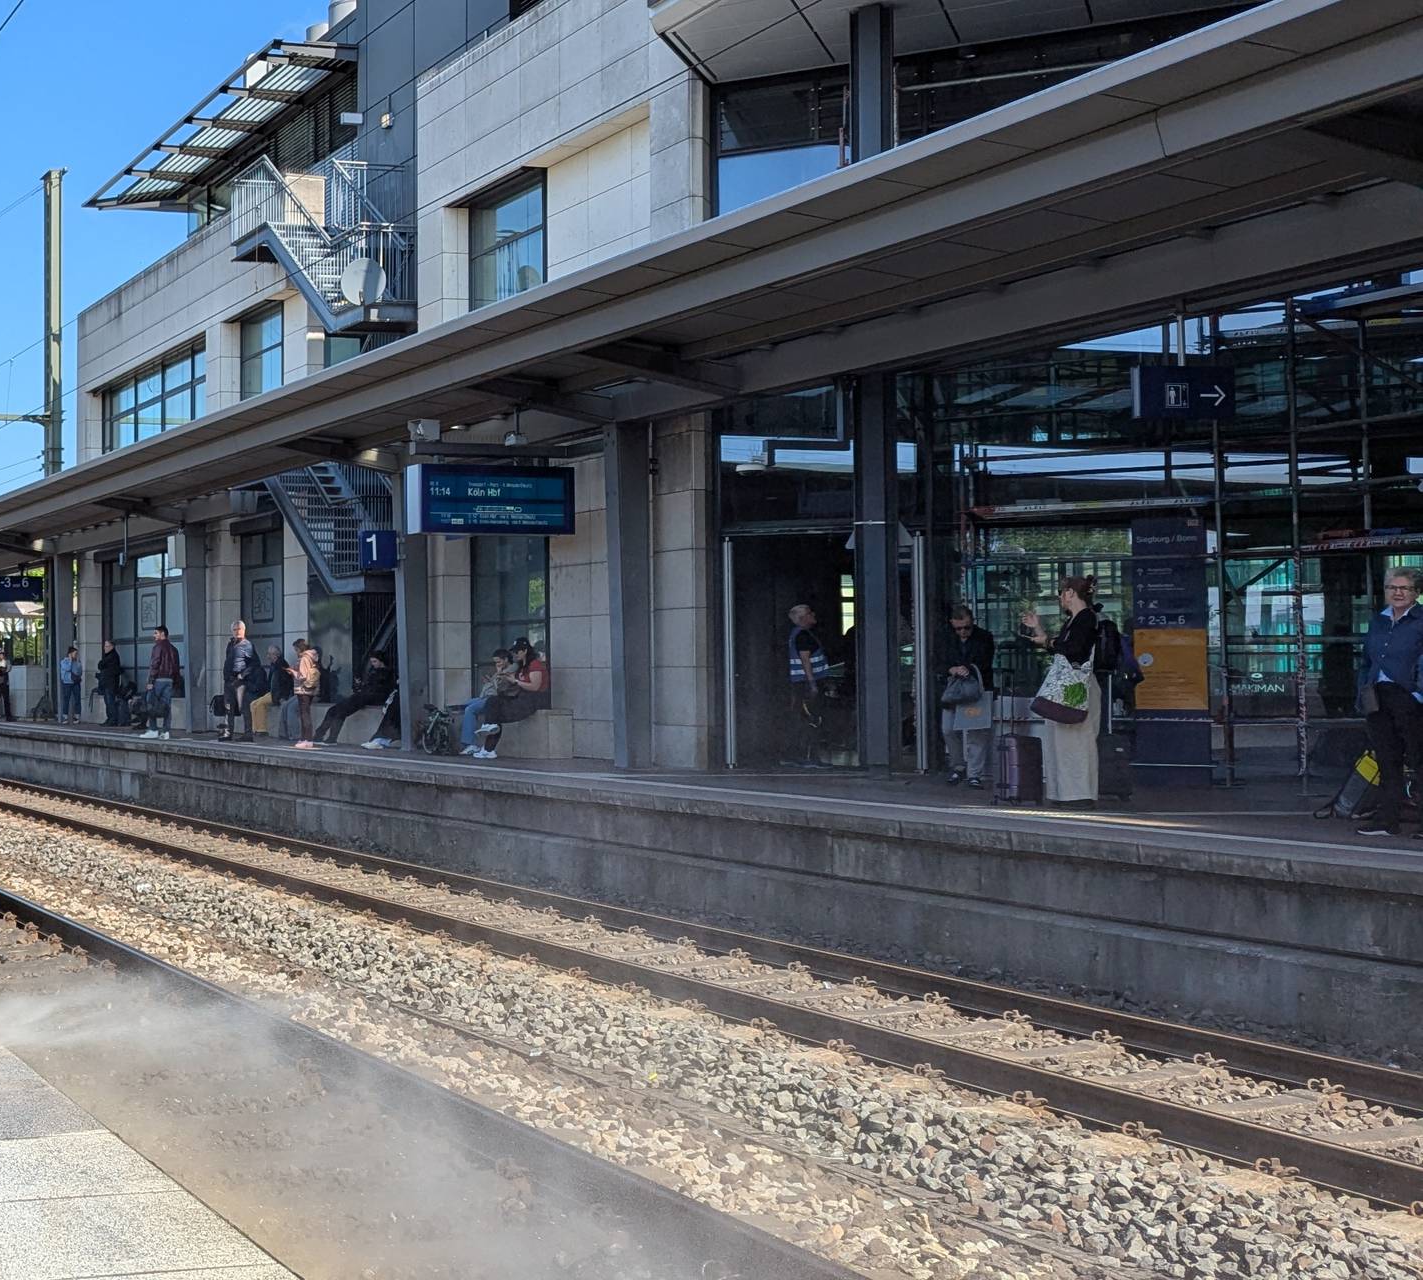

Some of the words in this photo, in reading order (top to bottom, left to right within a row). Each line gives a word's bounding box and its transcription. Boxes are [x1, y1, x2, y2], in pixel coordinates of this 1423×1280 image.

[429, 487, 451, 496] 11:14
[467, 486, 485, 497] Köln
[487, 487, 501, 497] Hbf
[1136, 535, 1170, 544] Siegburg
[366, 533, 377, 561] 1
[21, 577, 30, 588] 6
[1147, 615, 1167, 625] 2-3
[1178, 615, 1186, 625] 6
